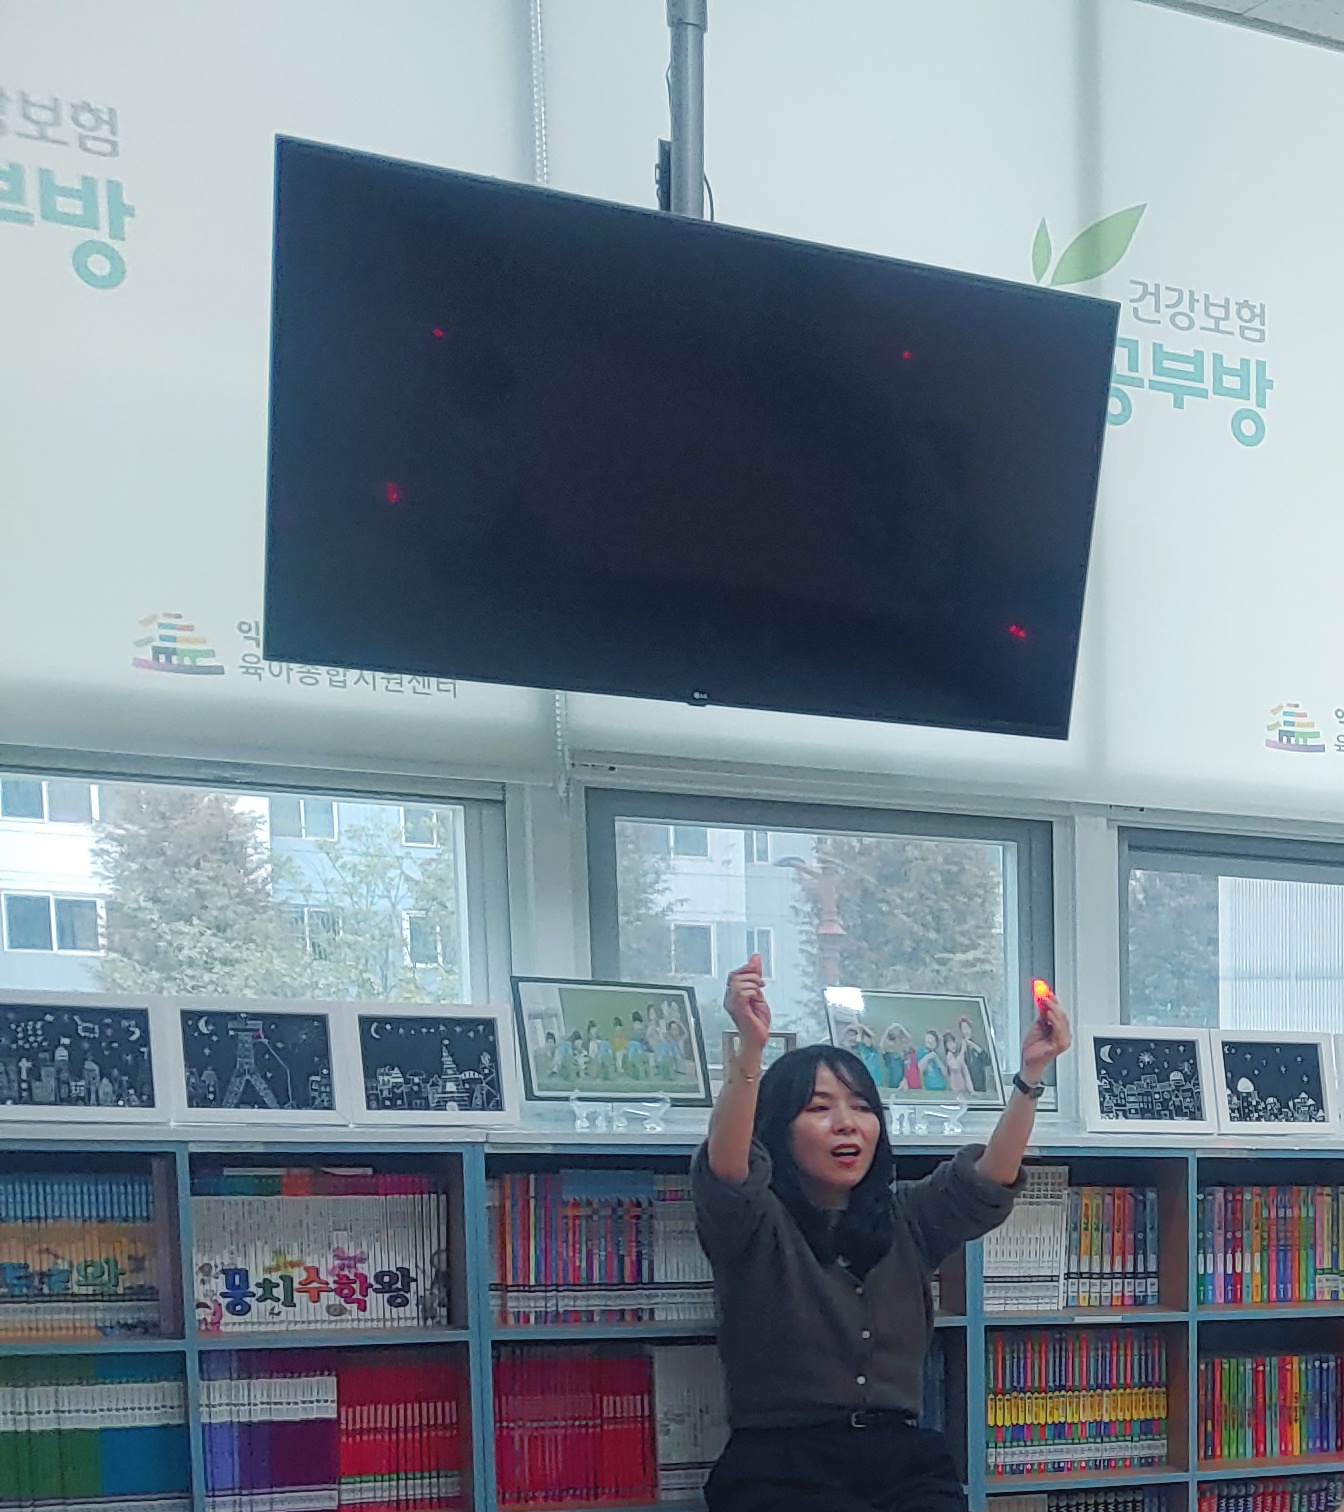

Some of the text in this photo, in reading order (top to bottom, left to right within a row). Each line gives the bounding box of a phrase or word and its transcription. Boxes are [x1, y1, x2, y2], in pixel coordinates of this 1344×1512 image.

[0, 88, 120, 158] 보험
[1129, 279, 1267, 344] 건강보험
[1107, 336, 1275, 447] 공부방
